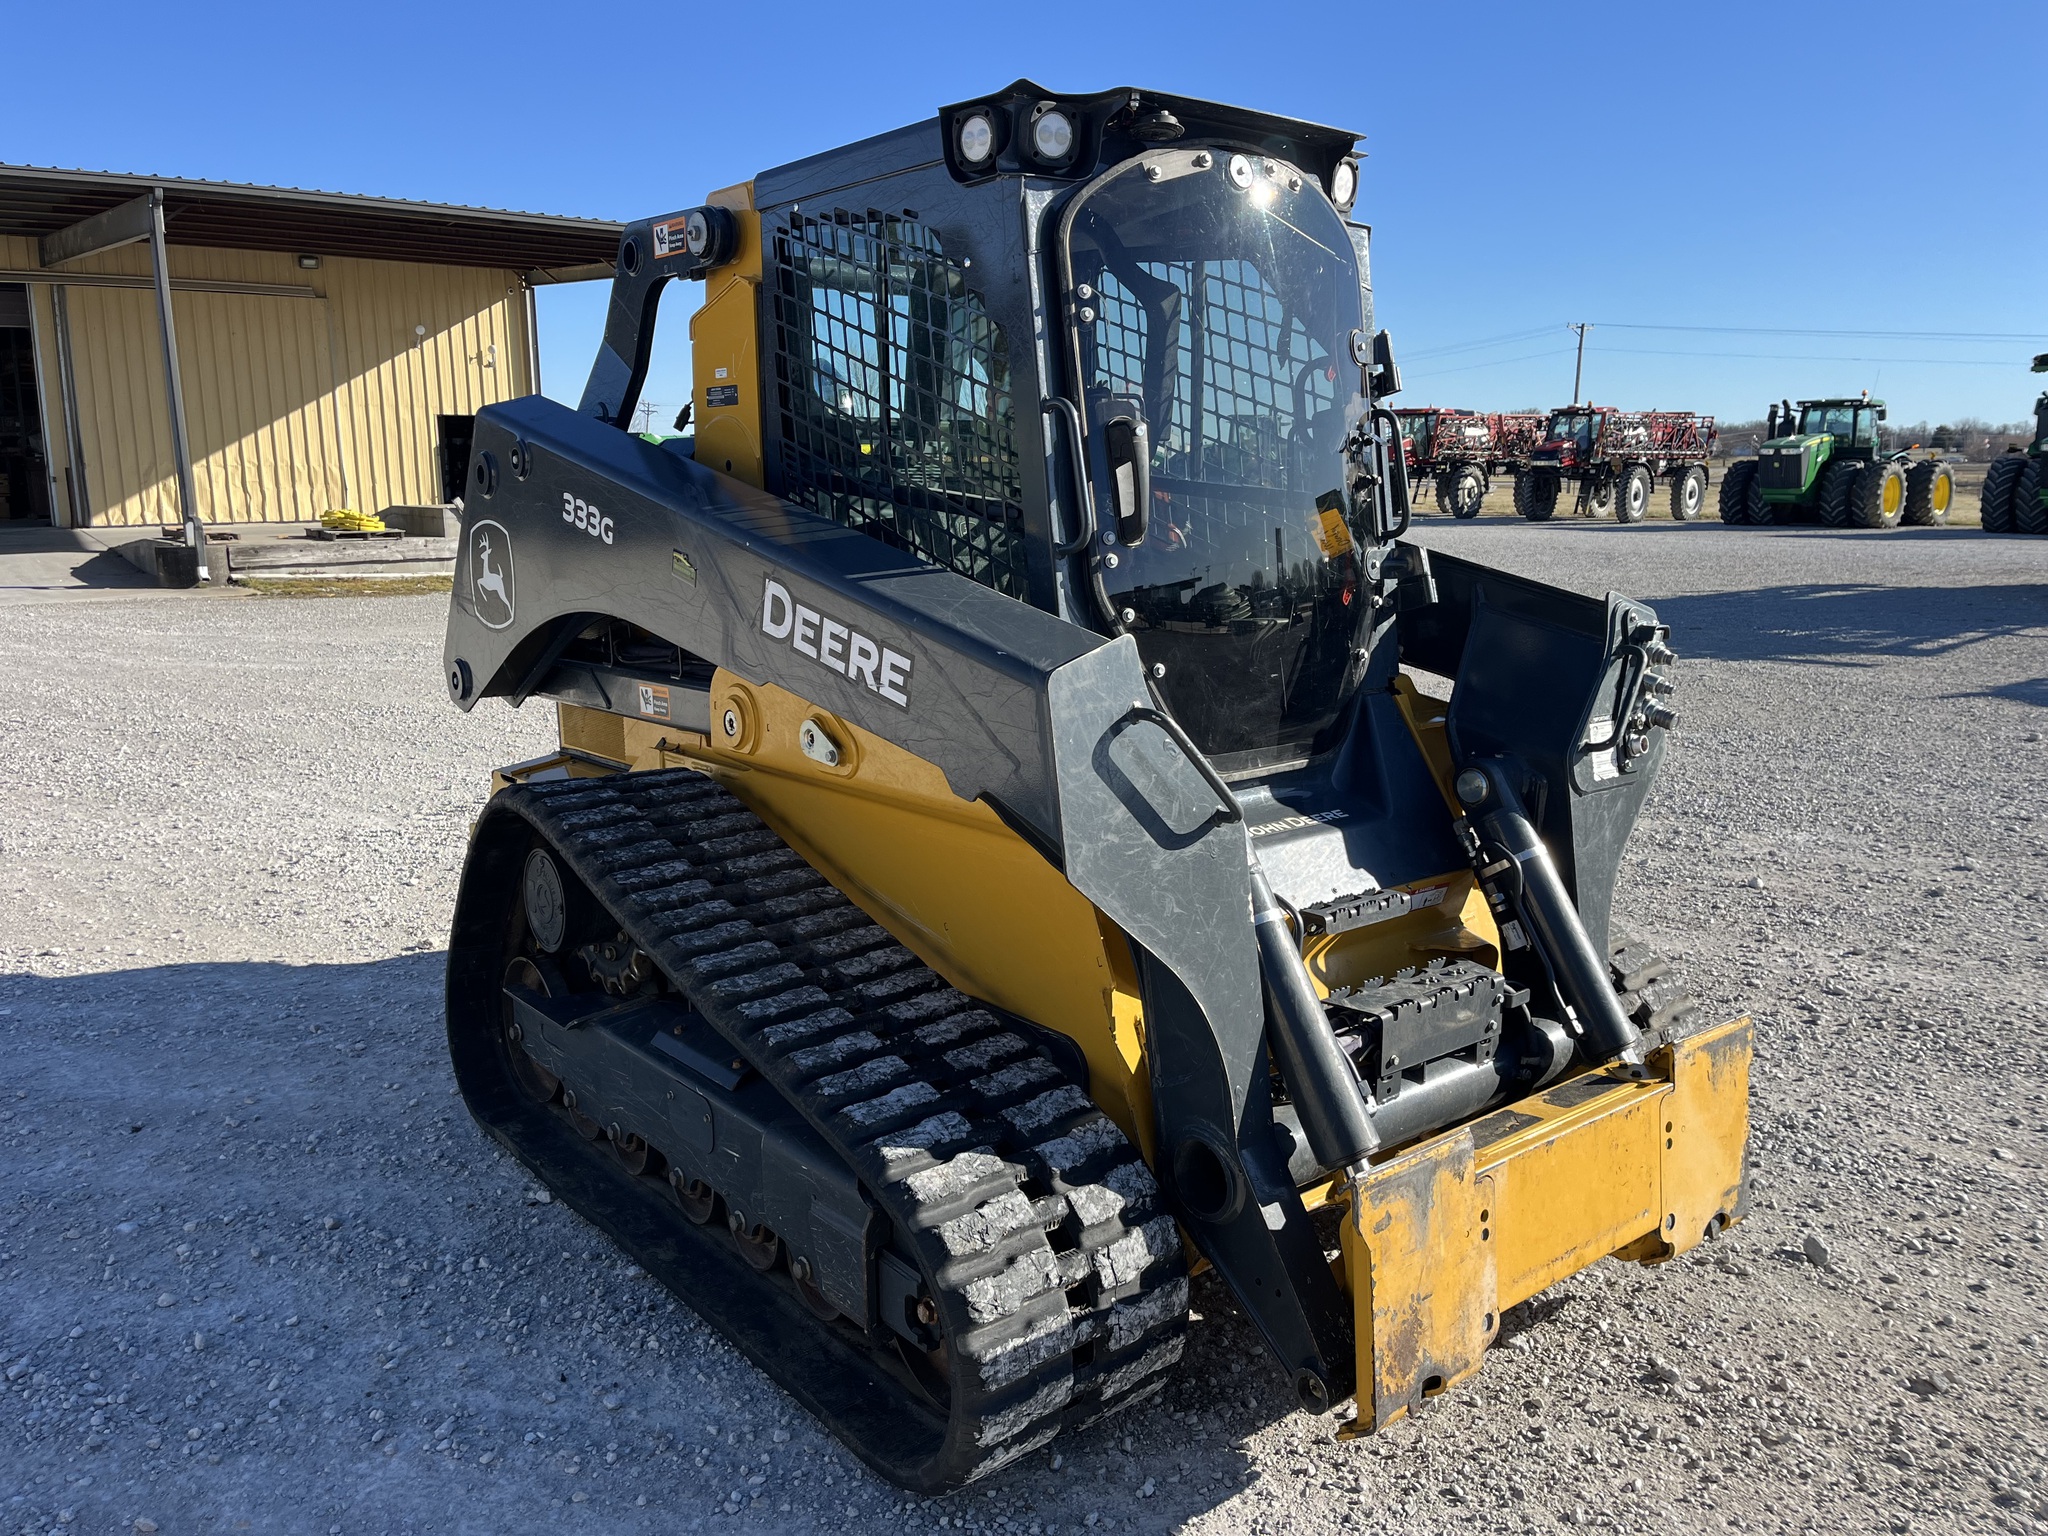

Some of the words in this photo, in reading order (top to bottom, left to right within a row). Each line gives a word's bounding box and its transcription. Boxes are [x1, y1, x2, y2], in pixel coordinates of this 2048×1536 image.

[562, 492, 614, 545] 333G
[762, 578, 912, 708] DEERE
[1249, 821, 1292, 838] OHN
[1284, 809, 1350, 828] DEERE
